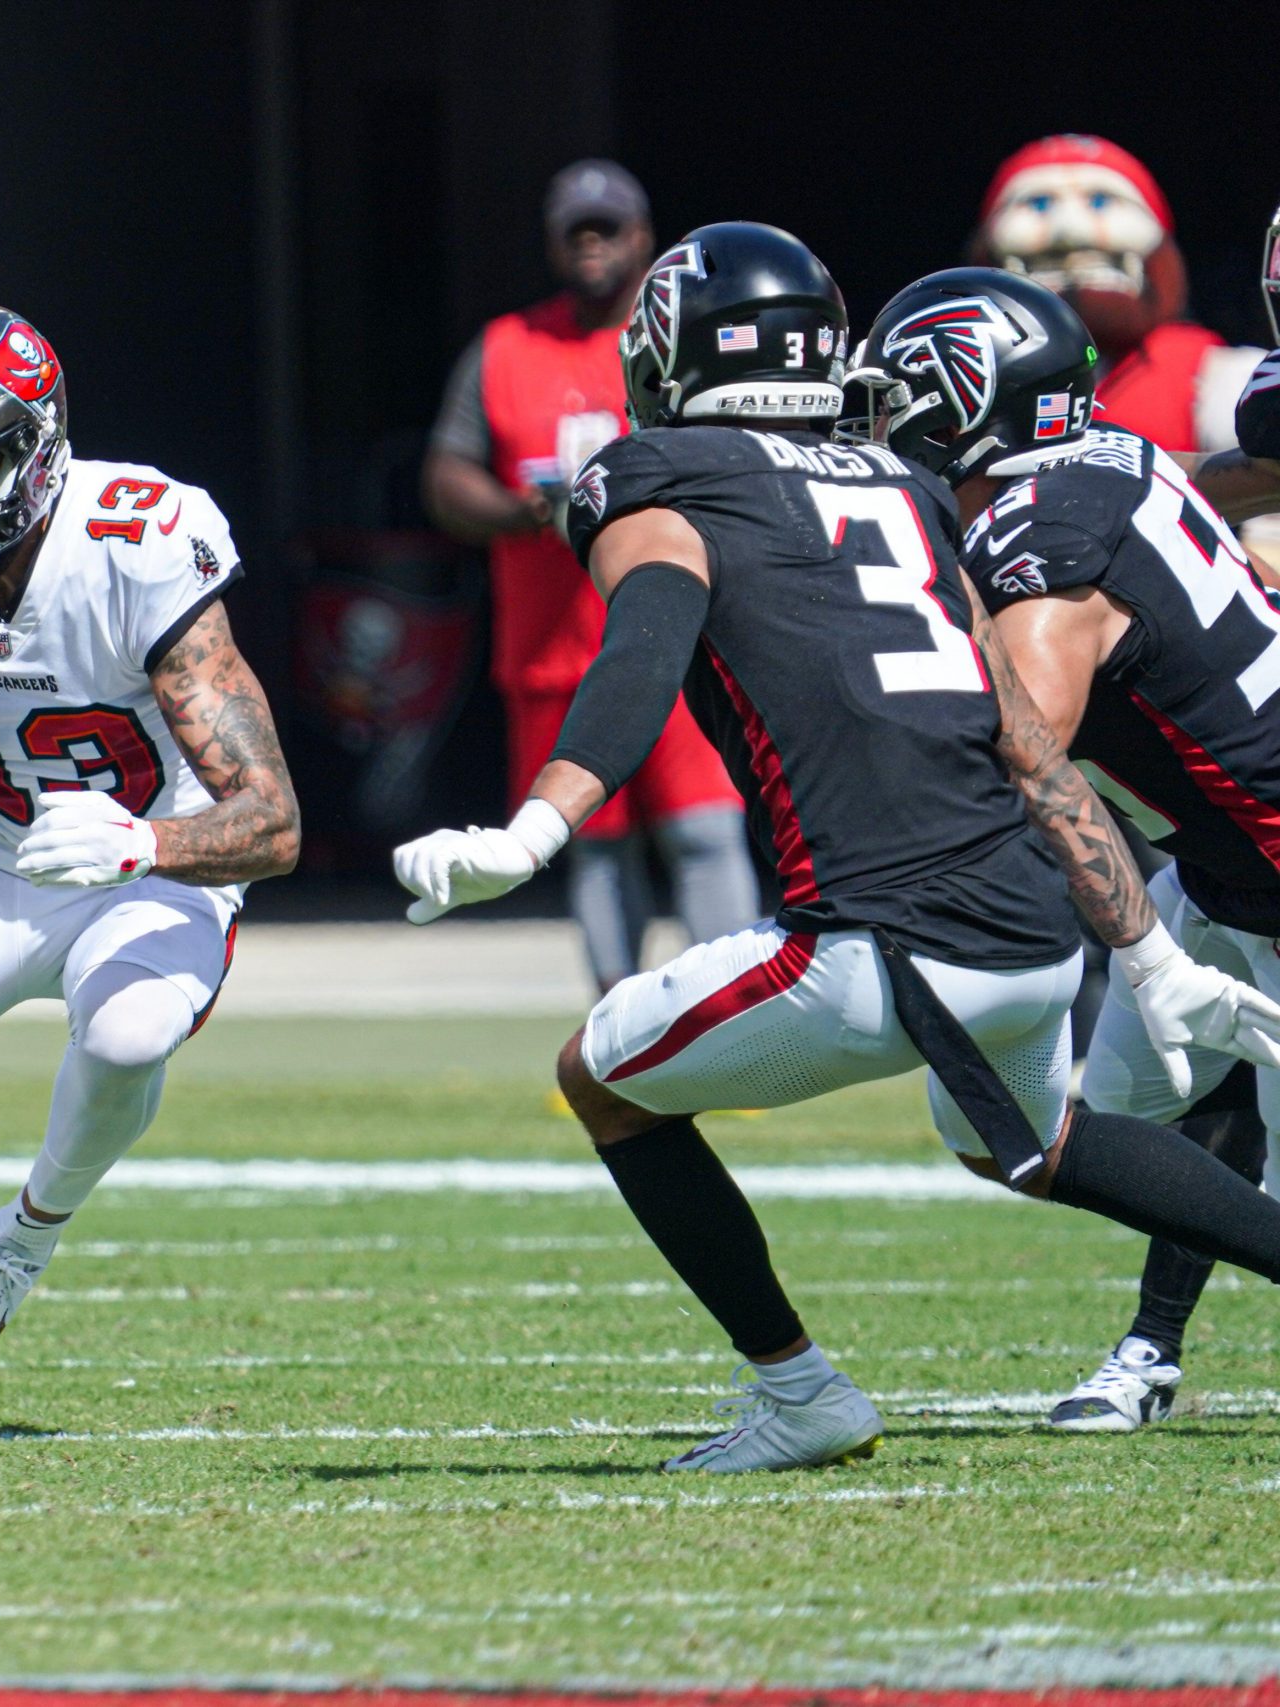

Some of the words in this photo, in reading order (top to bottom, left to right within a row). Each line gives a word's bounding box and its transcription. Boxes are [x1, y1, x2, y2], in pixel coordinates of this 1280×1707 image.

[785, 332, 806, 367] 3
[721, 394, 840, 409] FALCONS
[86, 477, 169, 545] 13
[806, 479, 991, 693] 3
